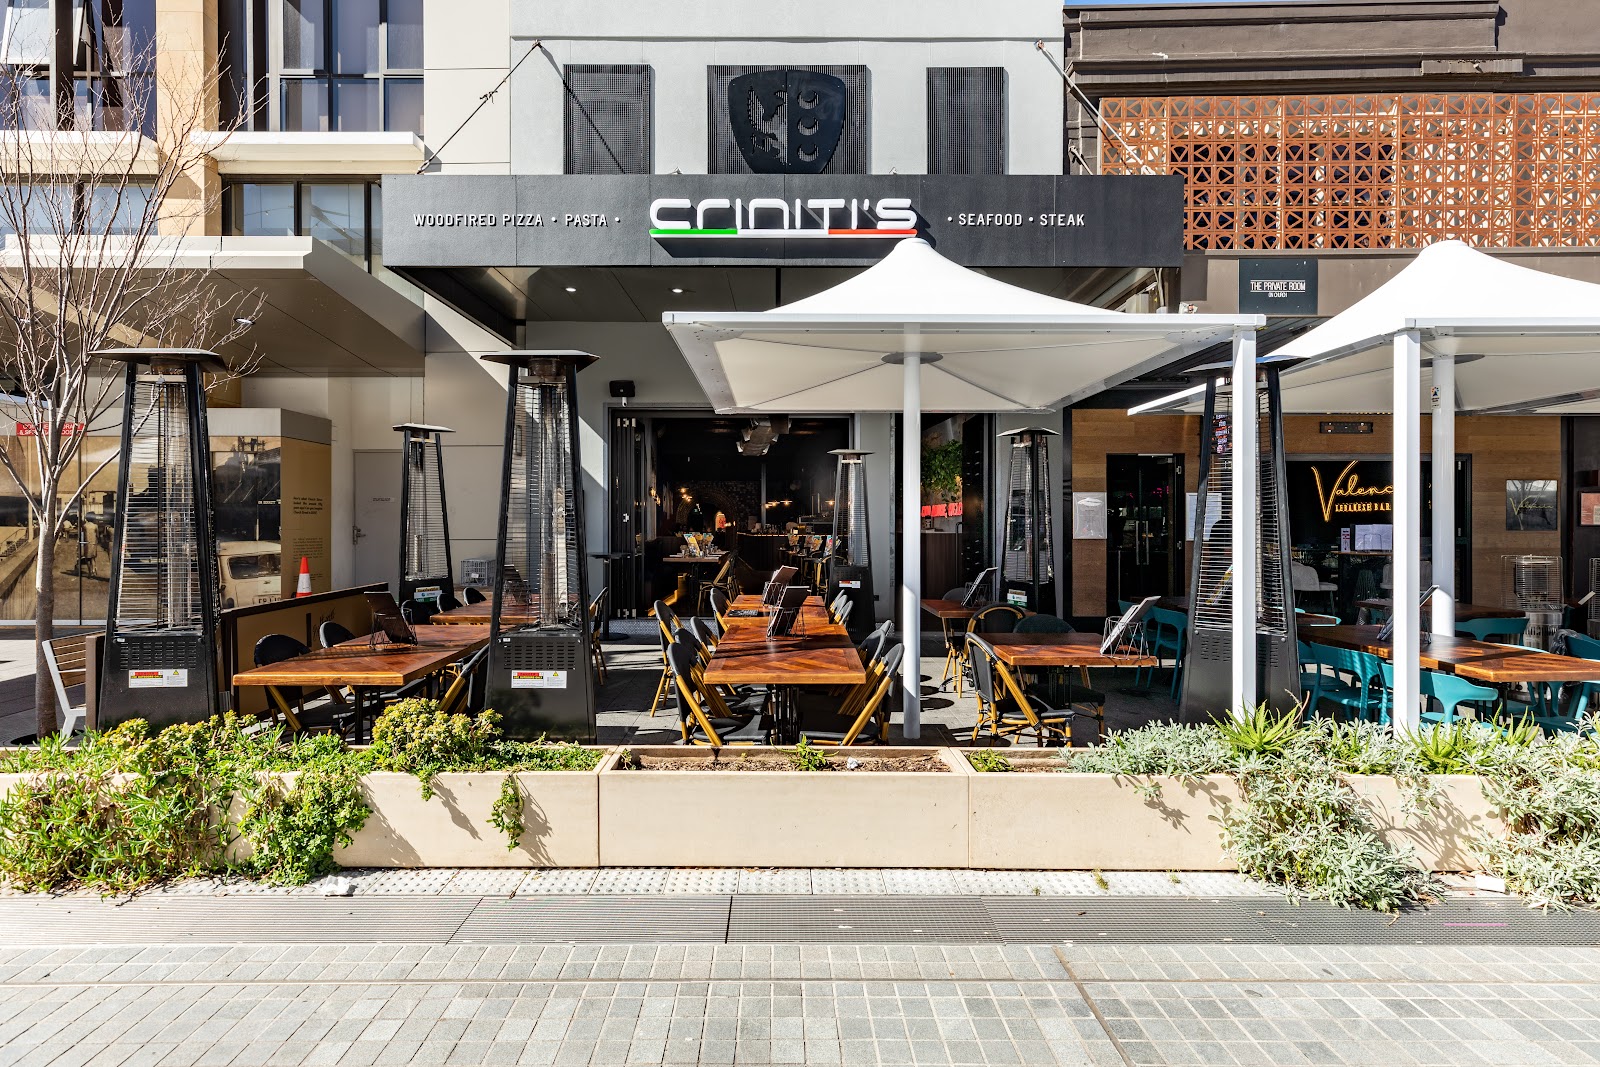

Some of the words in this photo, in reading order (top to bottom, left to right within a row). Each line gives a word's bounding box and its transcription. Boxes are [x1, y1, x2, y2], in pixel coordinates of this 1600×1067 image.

[413, 213, 497, 227] WOODFIRED
[502, 213, 544, 227] PIZZA
[565, 213, 608, 227] PASTA
[958, 213, 1023, 227] SEAFOOD
[1040, 213, 1085, 227] STEAK
[1251, 281, 1262, 290] THE
[1263, 281, 1287, 290] PRIVATE
[1289, 281, 1305, 290] ROOM
[1335, 502, 1372, 512] LEBANESE
[1374, 502, 1392, 511] BAR
